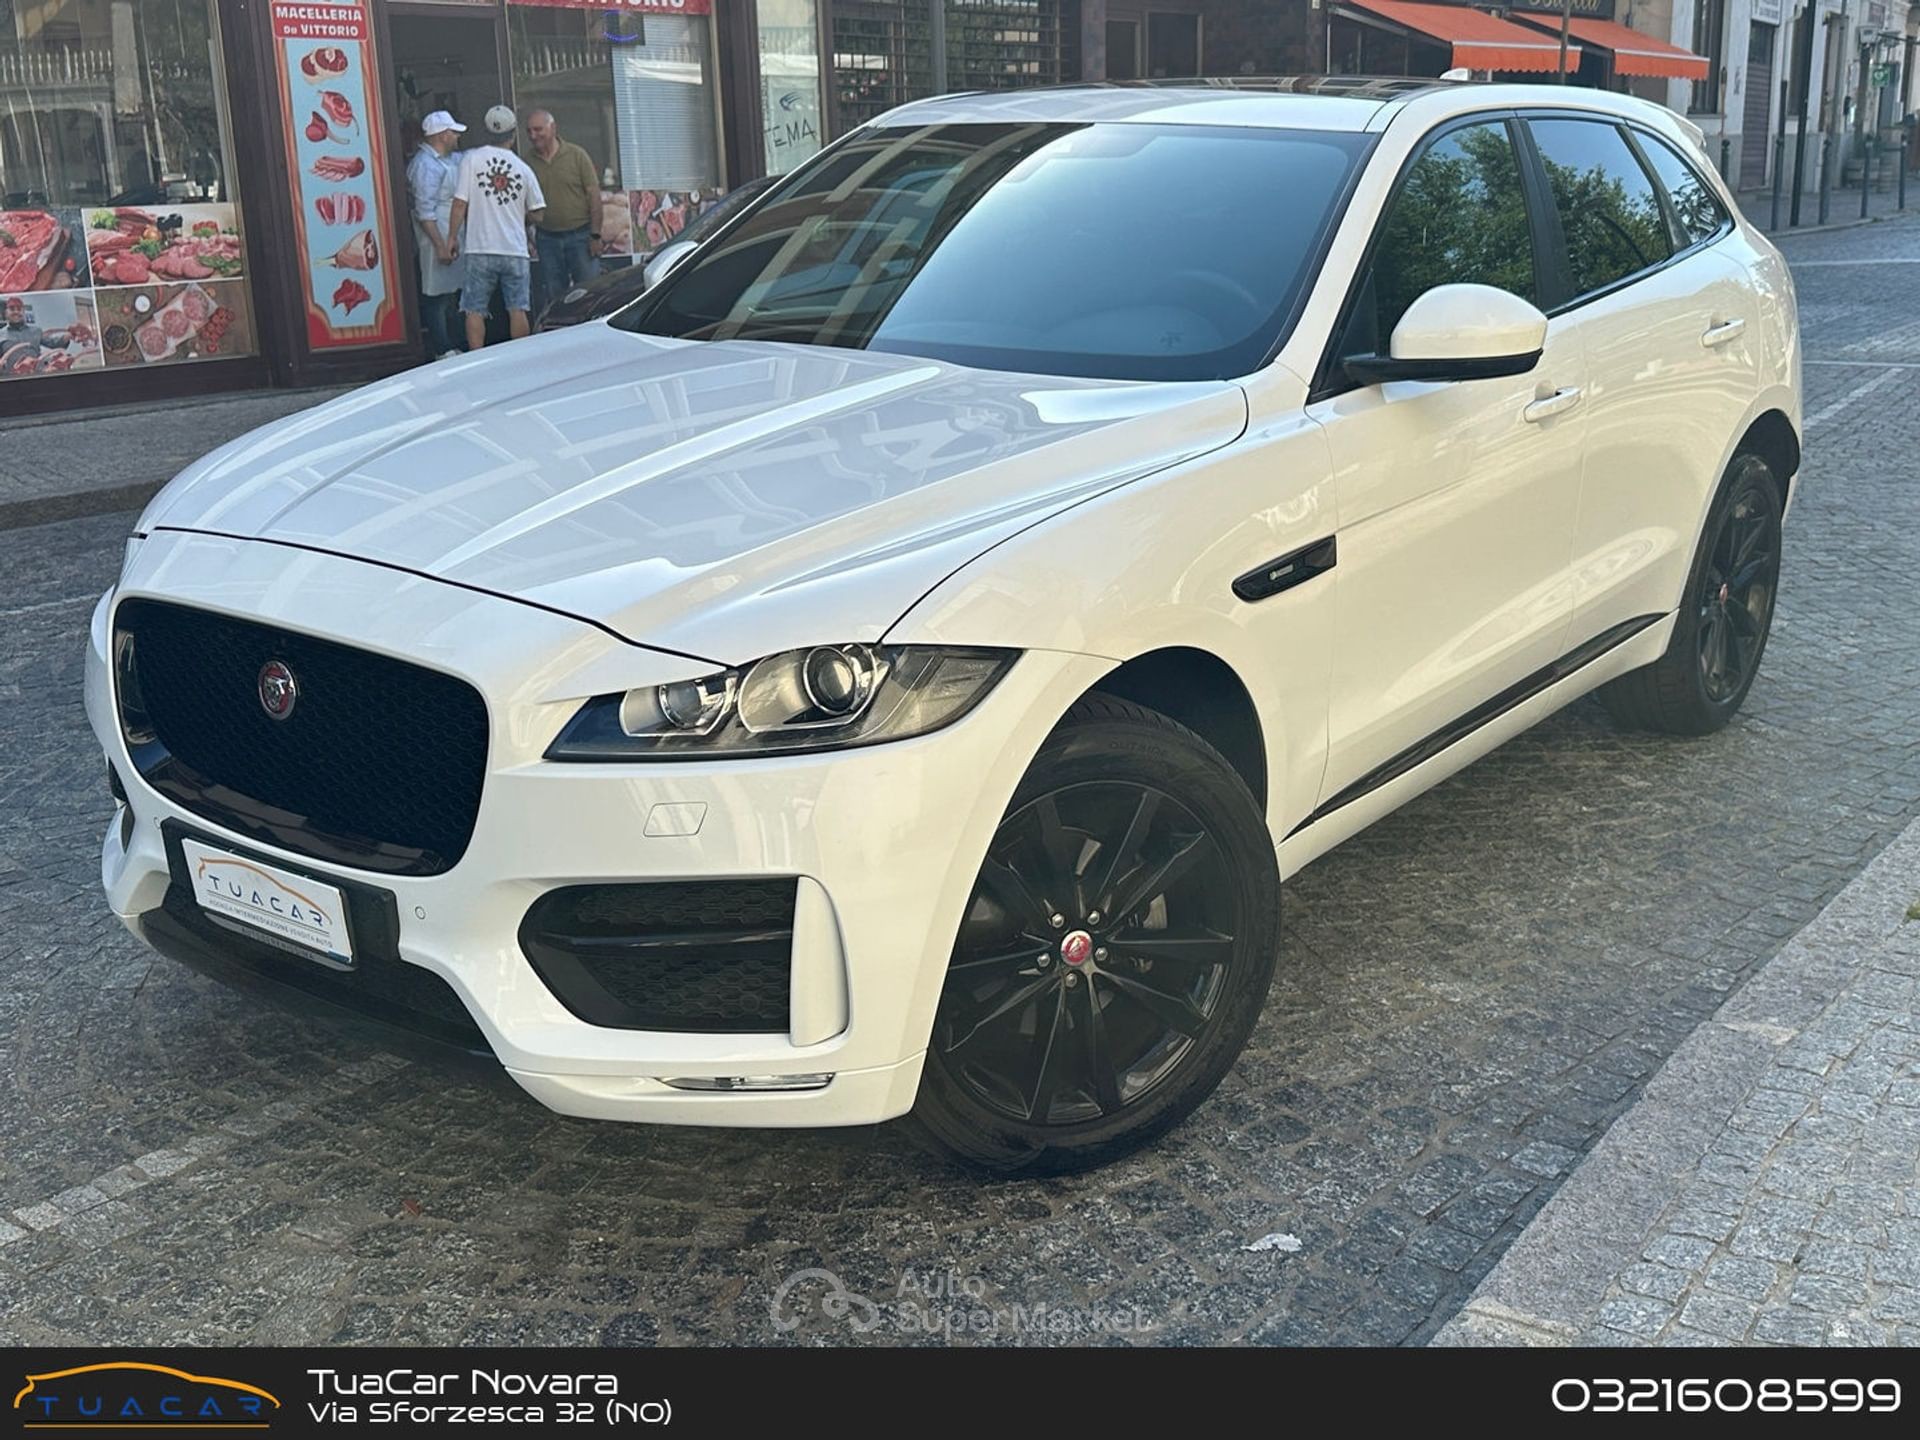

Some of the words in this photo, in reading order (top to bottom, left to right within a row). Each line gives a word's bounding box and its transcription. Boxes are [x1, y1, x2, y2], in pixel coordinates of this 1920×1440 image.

[275, 6, 362, 21] MACELLERIA
[301, 23, 359, 37] VITTORIO
[208, 875, 324, 927] TUACAR
